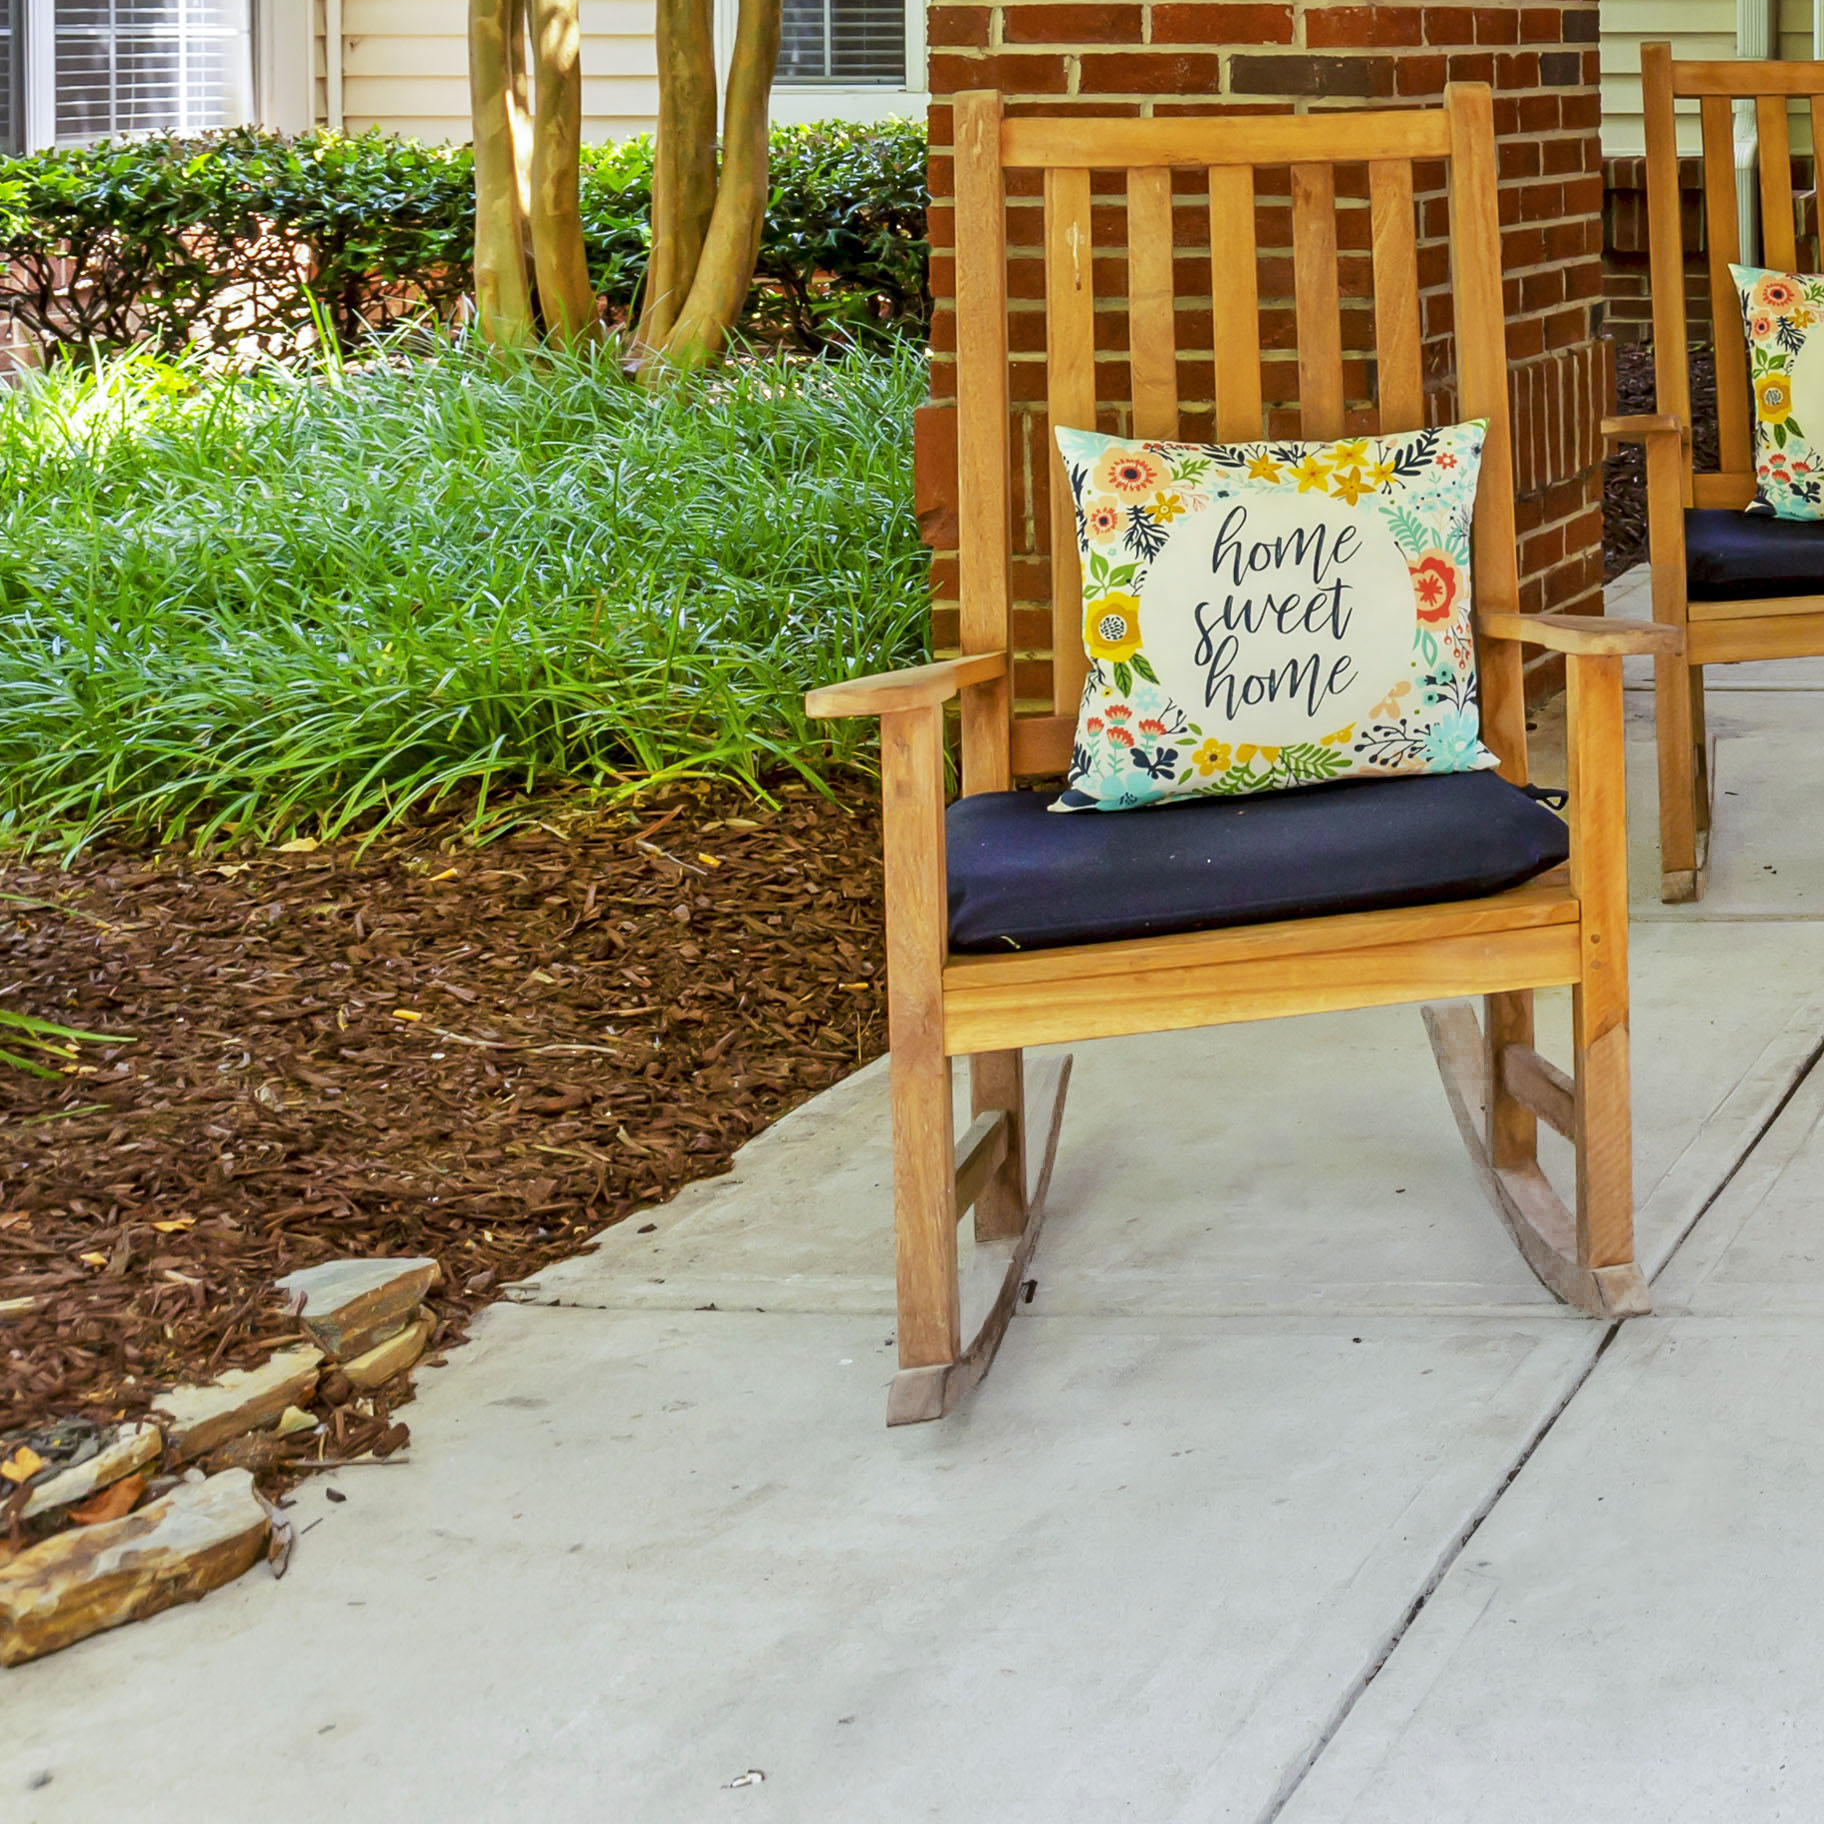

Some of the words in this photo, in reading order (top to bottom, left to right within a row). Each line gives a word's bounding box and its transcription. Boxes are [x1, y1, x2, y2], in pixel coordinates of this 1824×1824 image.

[1212, 505, 1362, 586] home
[1194, 578, 1353, 666] sweet
[1205, 635, 1359, 721] home
